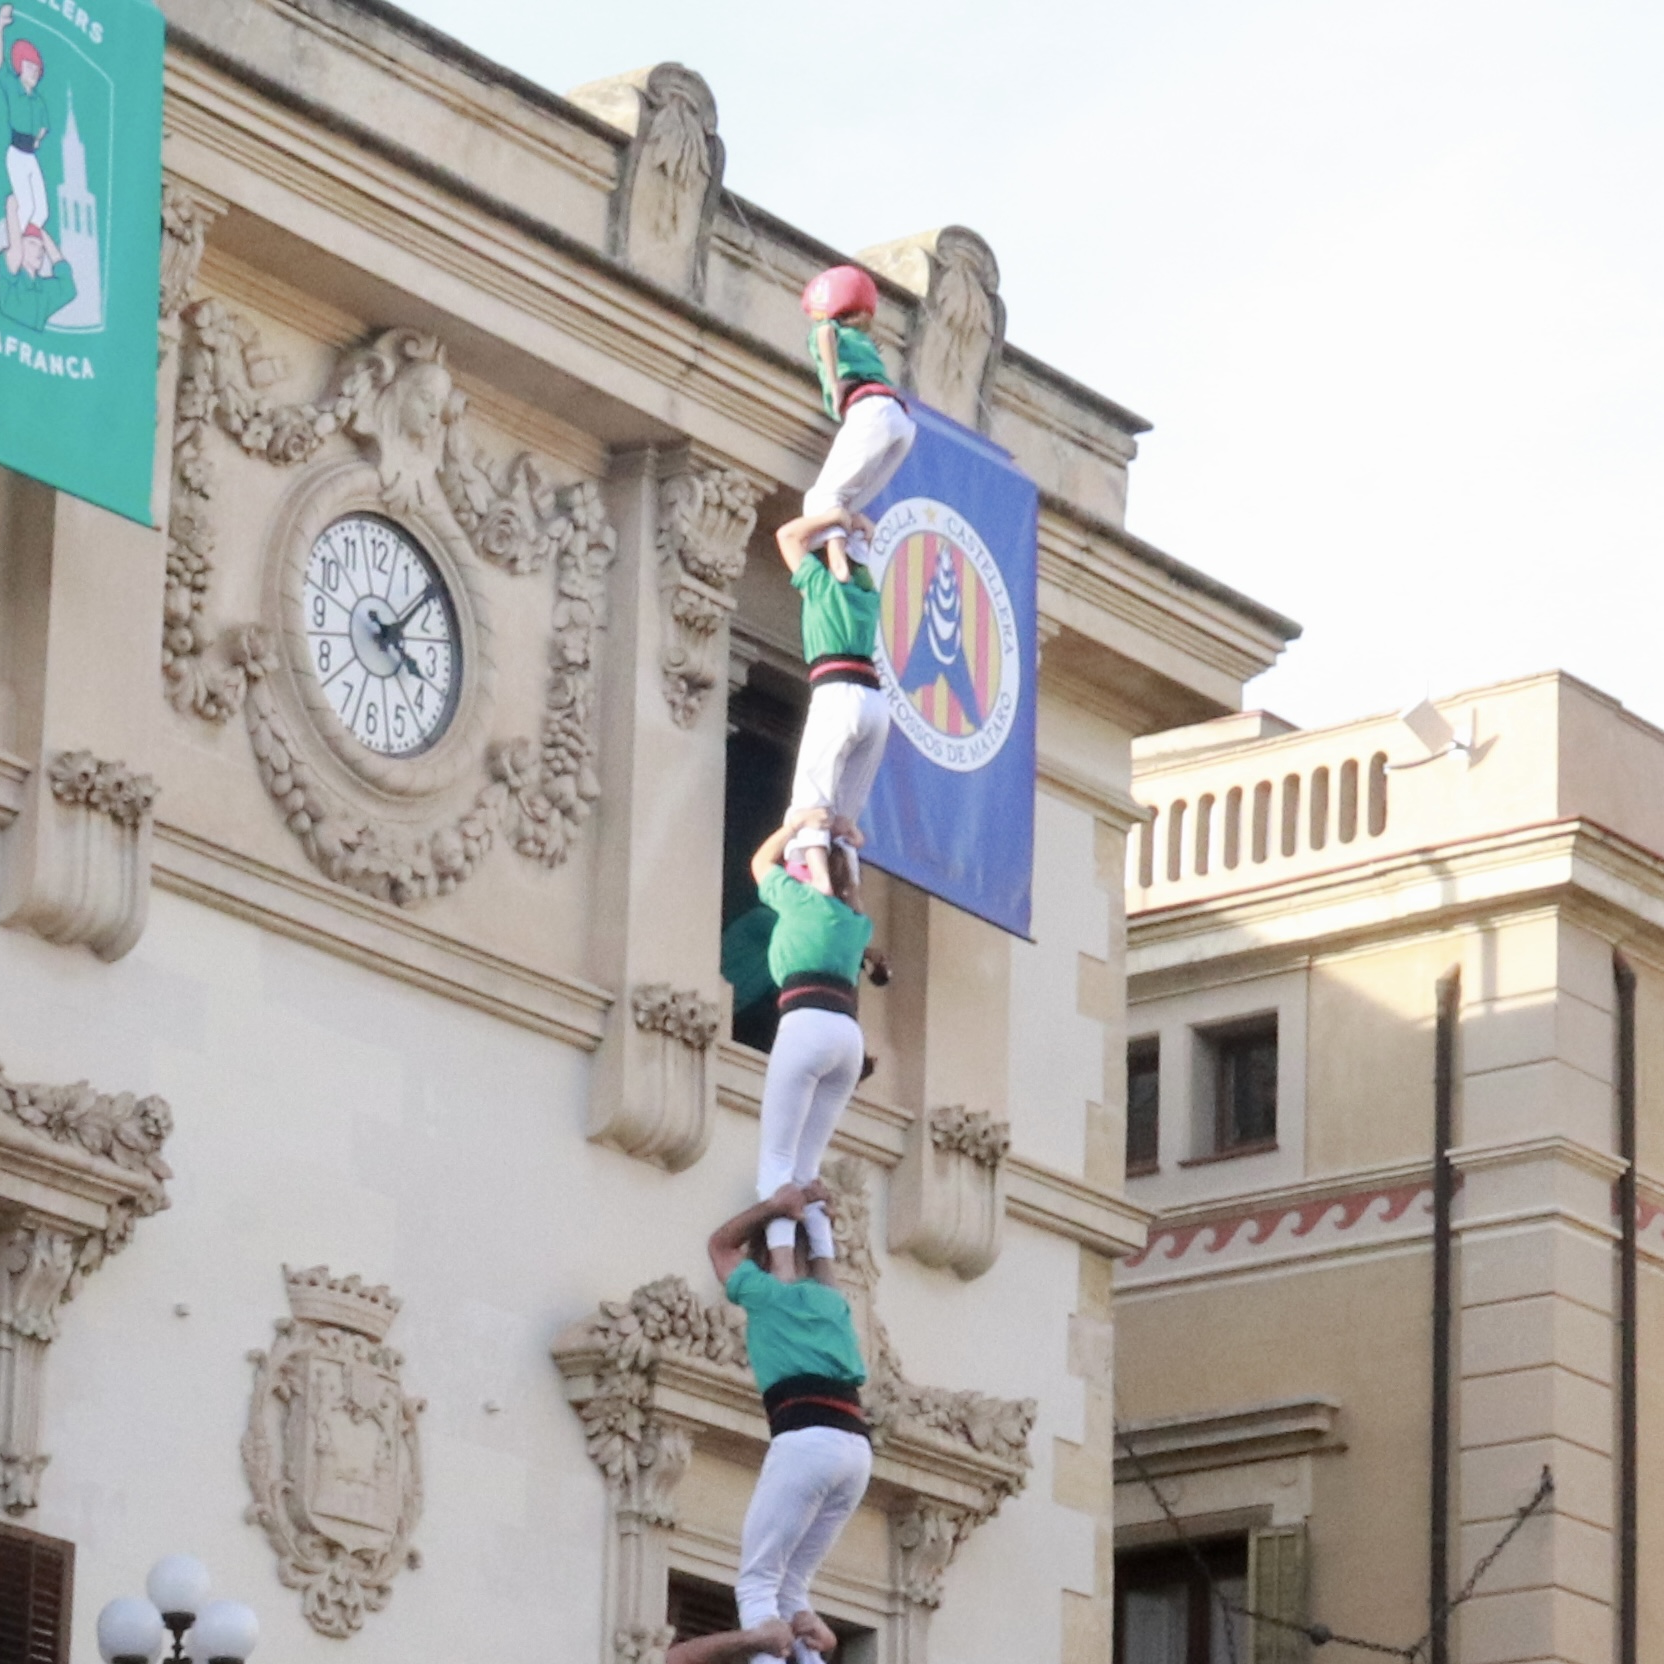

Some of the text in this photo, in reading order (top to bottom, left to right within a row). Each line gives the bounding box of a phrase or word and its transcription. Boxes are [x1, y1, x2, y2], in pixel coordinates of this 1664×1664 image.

[344, 536, 357, 571] 11
[321, 557, 339, 592] 10
[873, 507, 1014, 655] COLLA CASTELLERA
[314, 595, 326, 628] 9
[319, 640, 331, 672] 8
[426, 646, 437, 678] 3
[340, 681, 354, 715] 7
[415, 683, 424, 714] 4
[366, 702, 378, 735] 6
[393, 705, 405, 738] 5
[947, 743, 967, 763] DE
